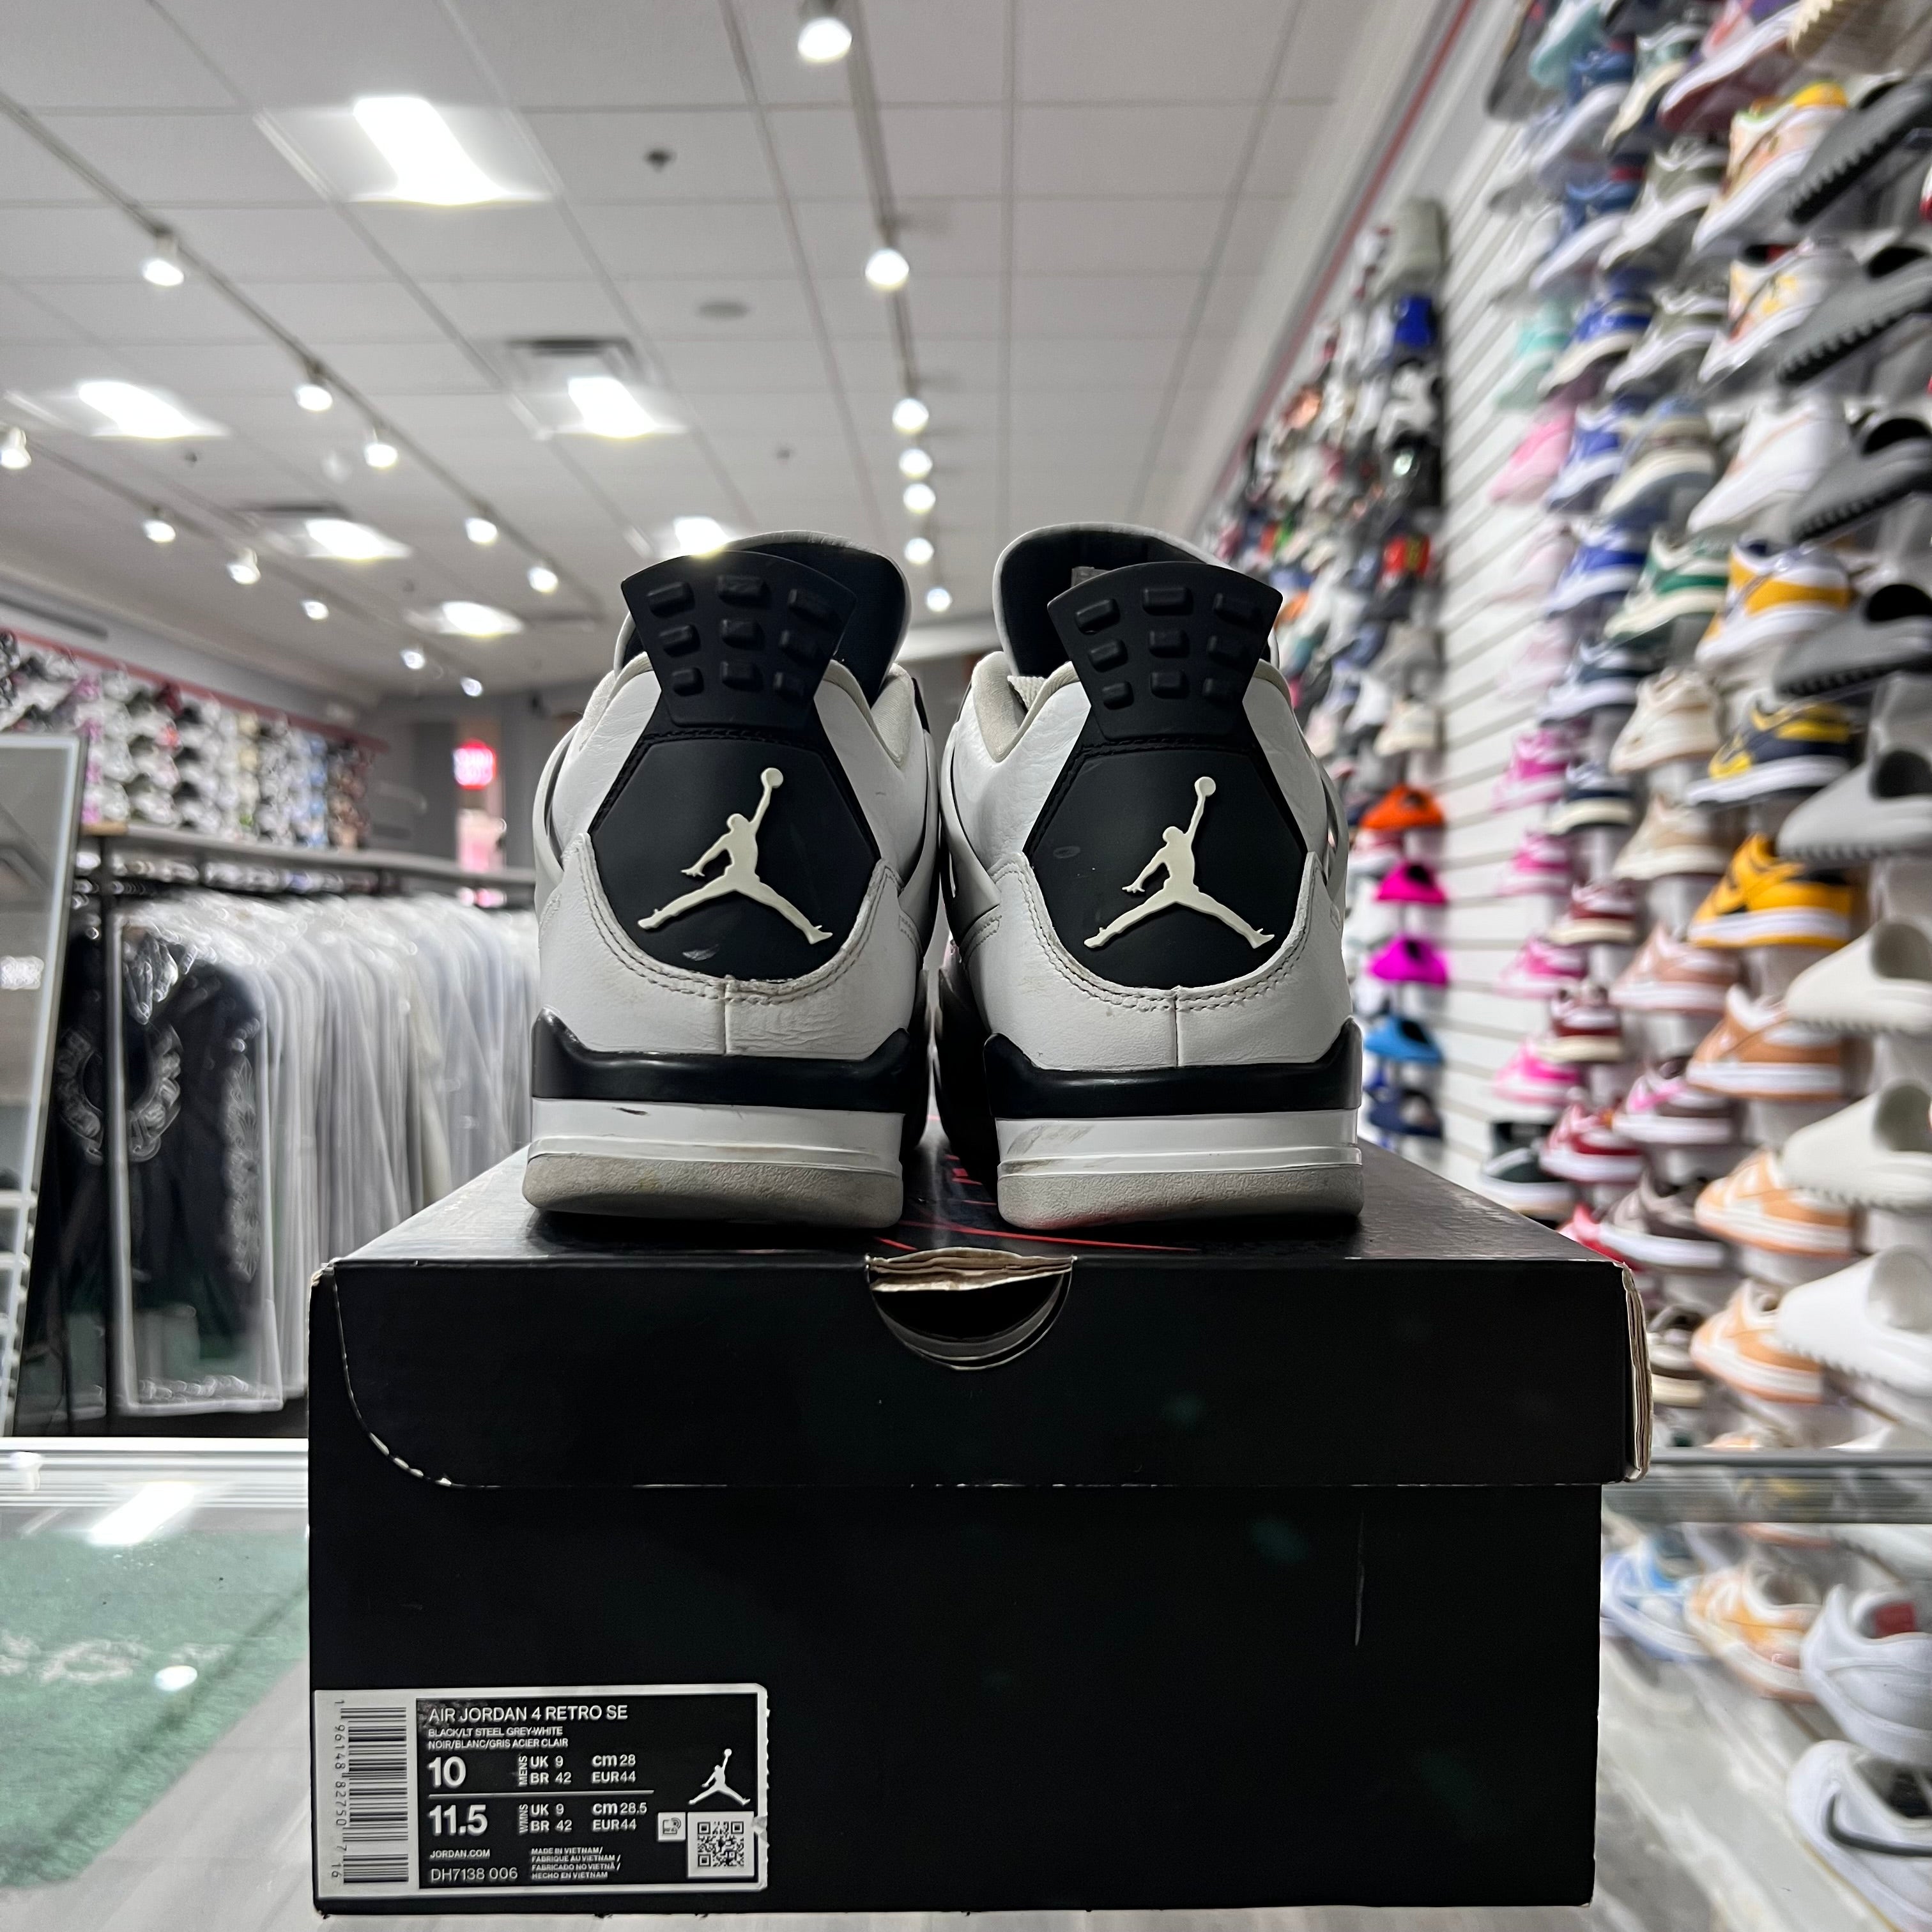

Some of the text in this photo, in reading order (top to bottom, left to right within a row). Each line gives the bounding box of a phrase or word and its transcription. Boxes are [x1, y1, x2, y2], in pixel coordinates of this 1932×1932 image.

[429, 1705, 628, 1722] AIR JORDAN 4 RETRO SE
[427, 1726, 563, 1738] BLACK/LT STEEL GREY-WHITE
[334, 1724, 346, 1769] 96148
[428, 1738, 569, 1750] NOIR/BLANC/GRIS ACIER CLAIR
[530, 1755, 564, 1769] UK 9
[427, 1756, 466, 1788] 10
[518, 1755, 528, 1787] MENS
[530, 1772, 572, 1786] BR 42
[335, 1781, 347, 1826] 82750
[530, 1803, 564, 1818] UK 9
[592, 1802, 647, 1816] cm 28.5
[427, 1804, 487, 1836] 11.5
[518, 1804, 528, 1836] WMNS
[530, 1820, 572, 1834] BR 42
[429, 1848, 491, 1860] JORDAN.COM
[431, 1867, 518, 1883] DH7138 006
